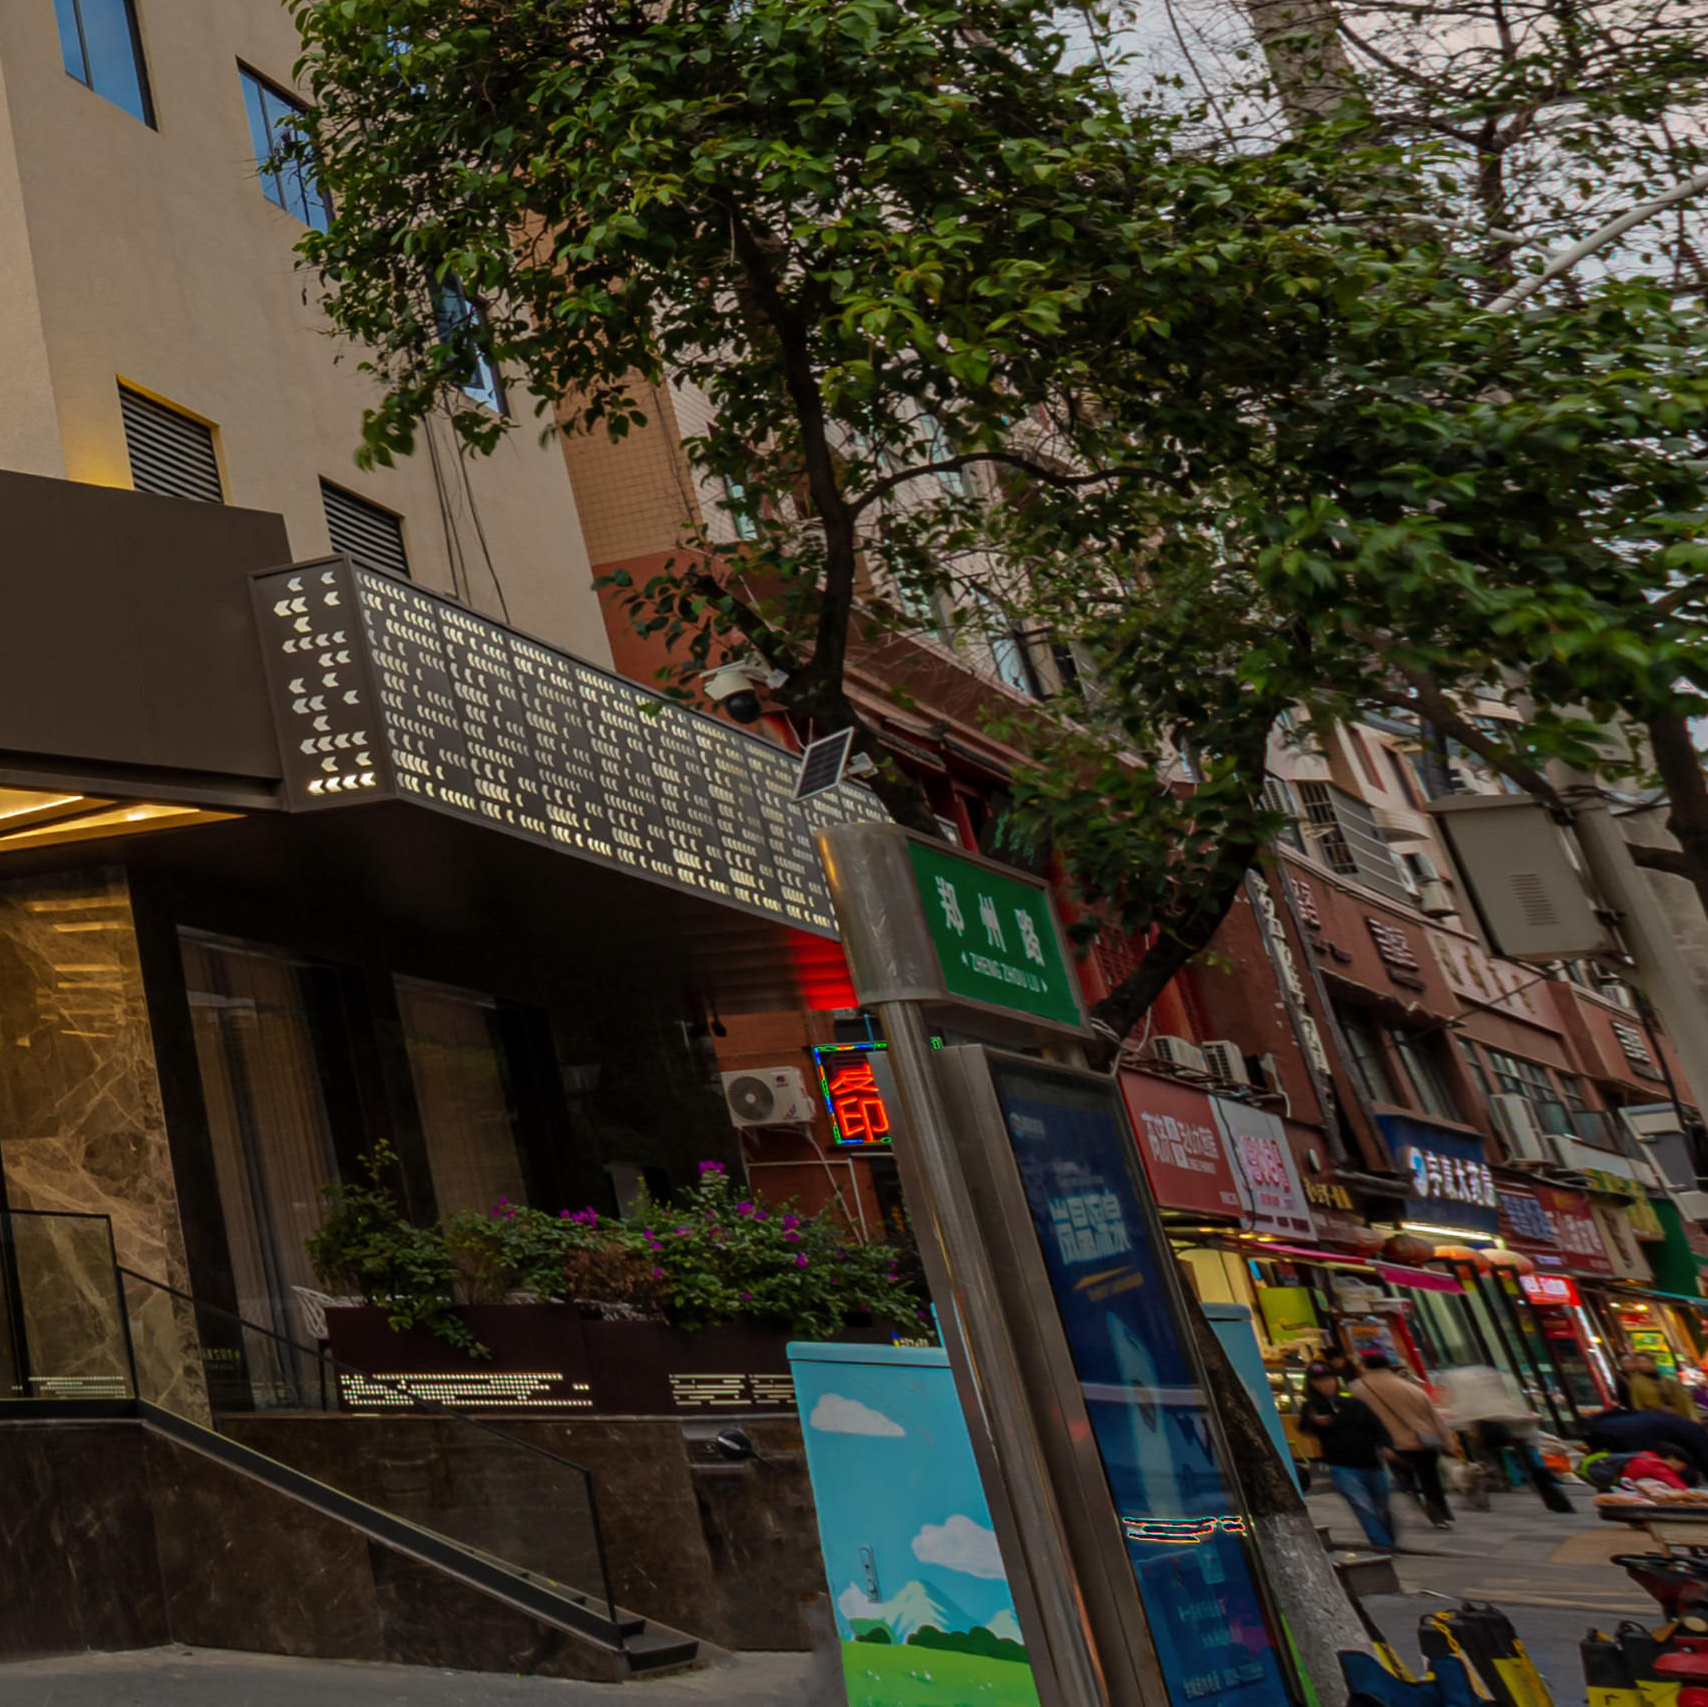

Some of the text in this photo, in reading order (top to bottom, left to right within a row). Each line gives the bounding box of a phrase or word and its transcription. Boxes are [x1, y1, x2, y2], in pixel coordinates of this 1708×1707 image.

[935, 875, 1045, 967] 郑州路
[969, 951, 1041, 992] ZHENG ZHOU LU
